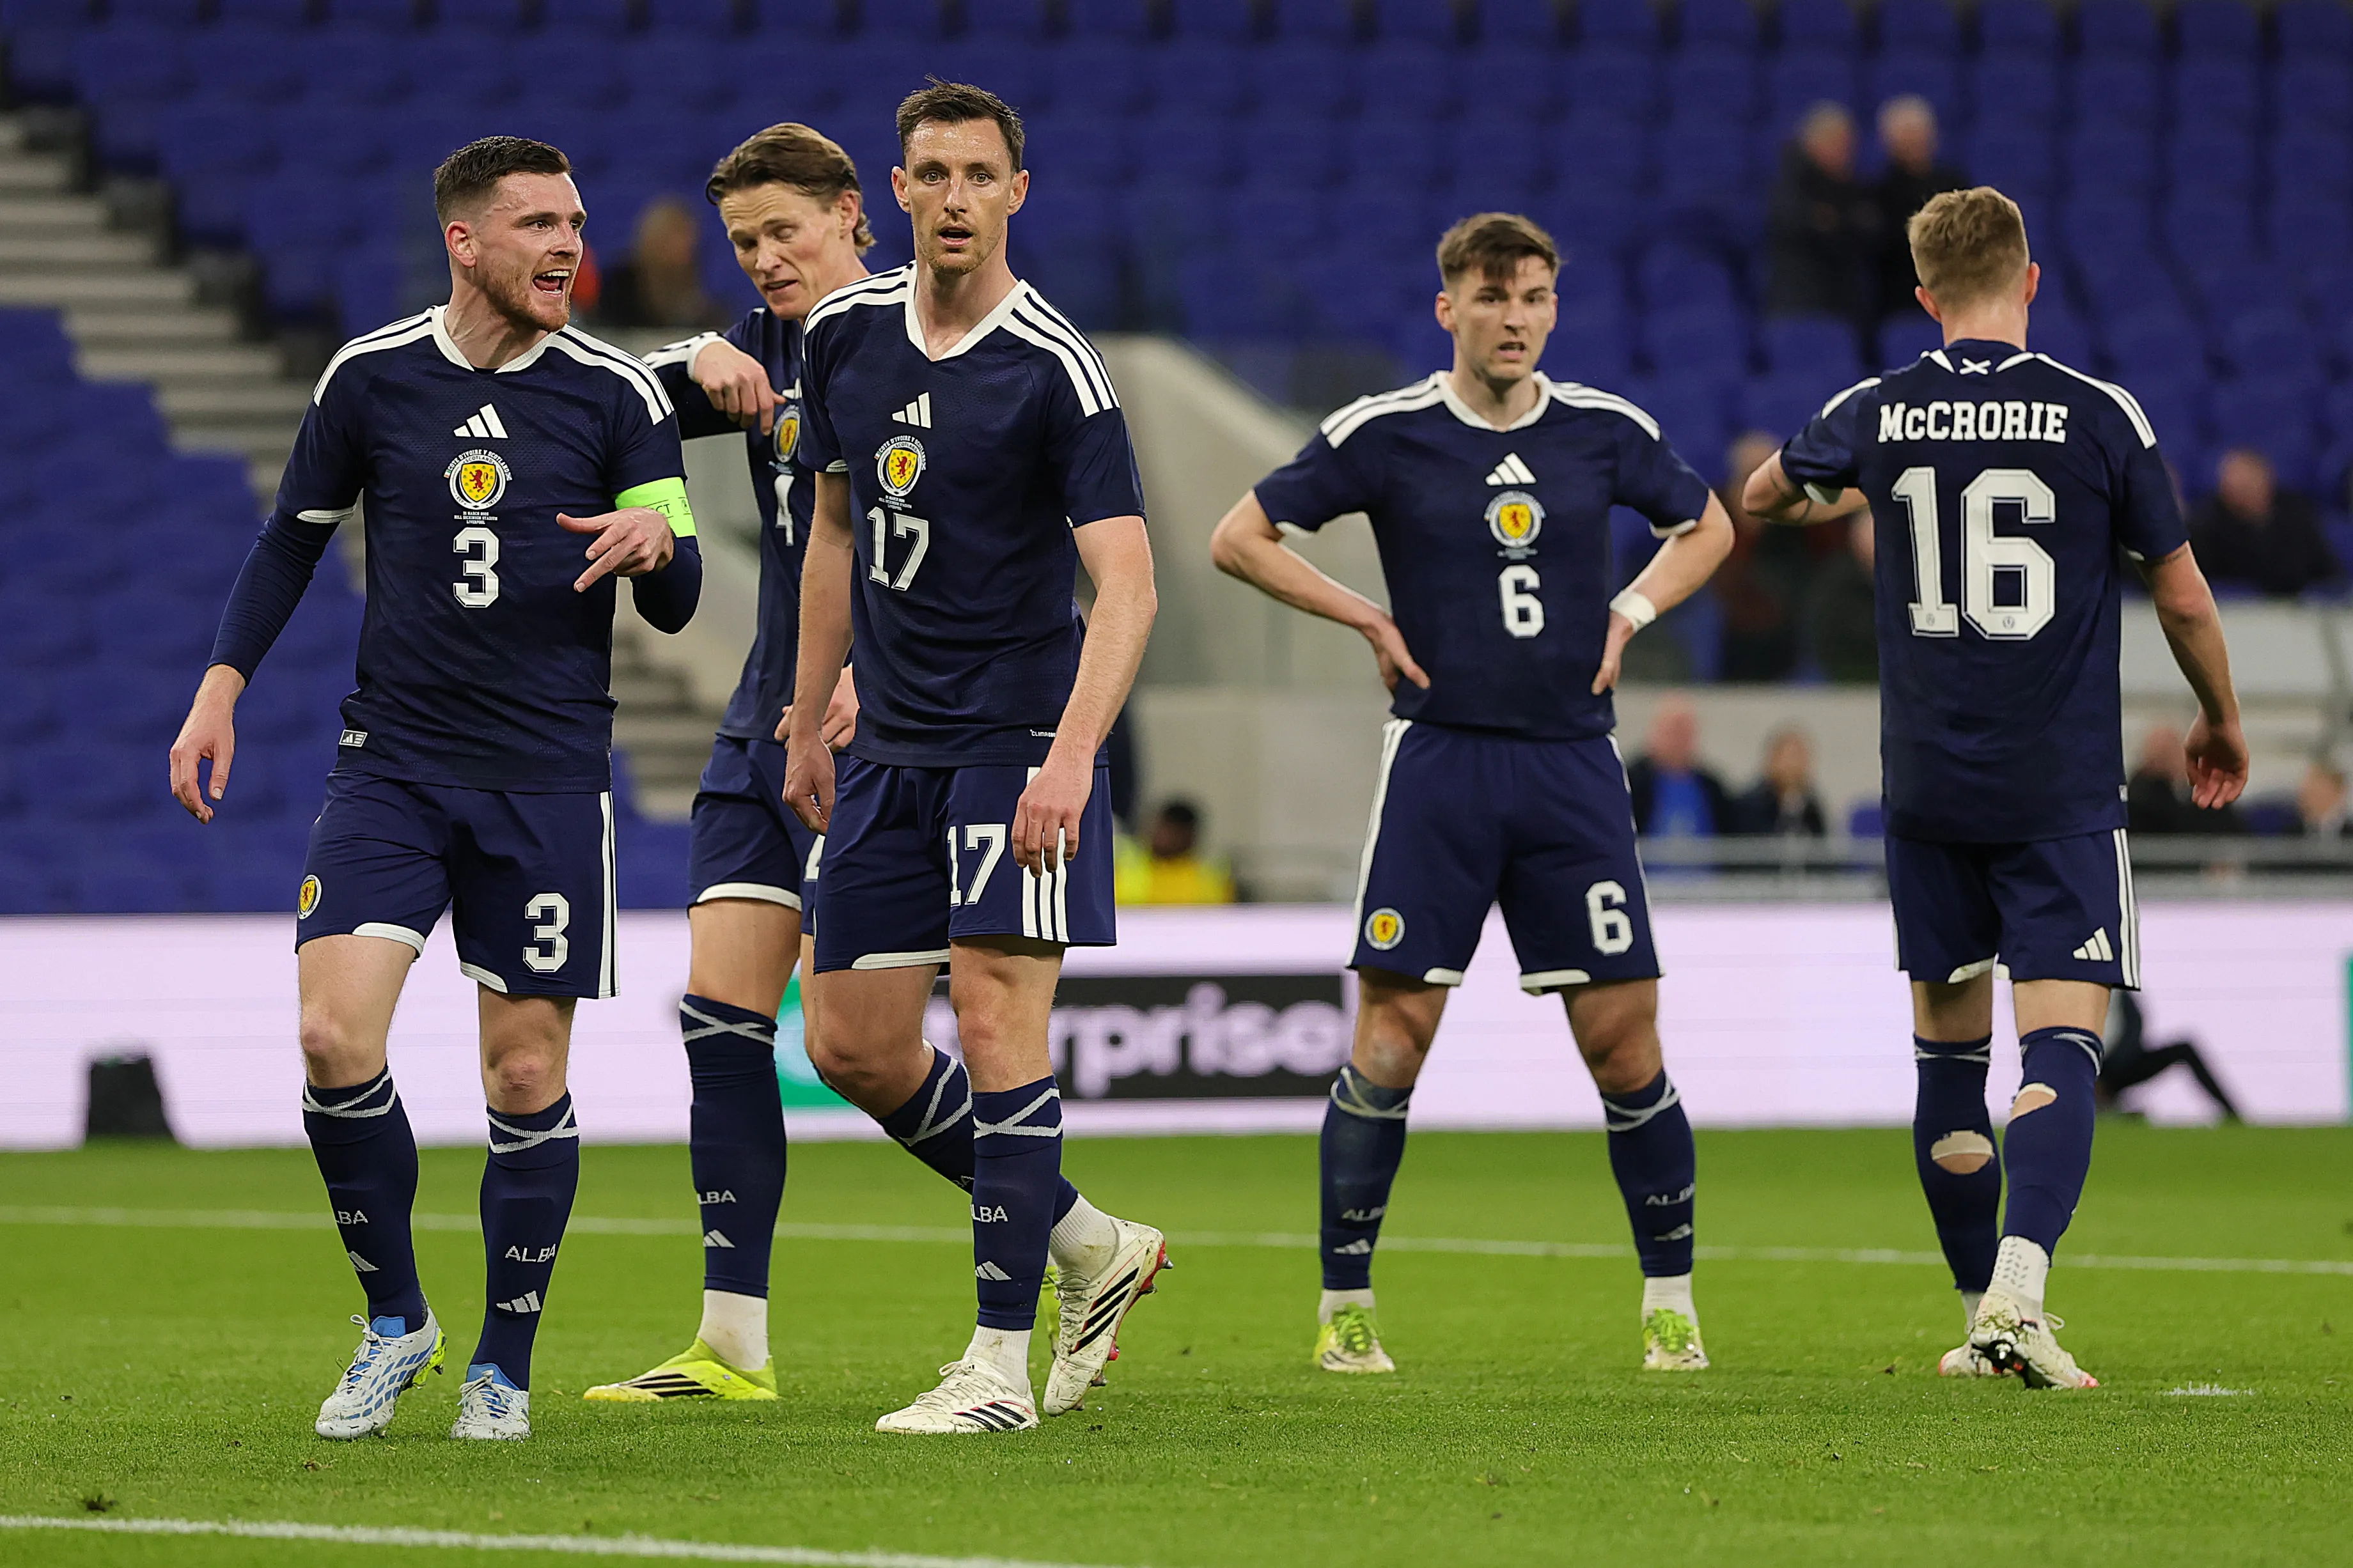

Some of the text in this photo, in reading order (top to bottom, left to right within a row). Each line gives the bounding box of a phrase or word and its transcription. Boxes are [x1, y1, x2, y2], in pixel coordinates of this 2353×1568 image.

[1878, 401, 2068, 444] McCRORIE
[487, 451, 510, 473] SCOTLAND
[453, 527, 499, 609] 3
[867, 506, 929, 591] 17
[1891, 466, 2056, 640] 16
[1497, 564, 1545, 639] 6
[947, 823, 1006, 908] 17
[522, 892, 570, 973] 3
[1585, 880, 1634, 956] 6
[336, 1210, 368, 1225] BA
[696, 1190, 737, 1205] LBA
[970, 1204, 1008, 1223] LBA
[505, 1243, 556, 1263] ALBA
